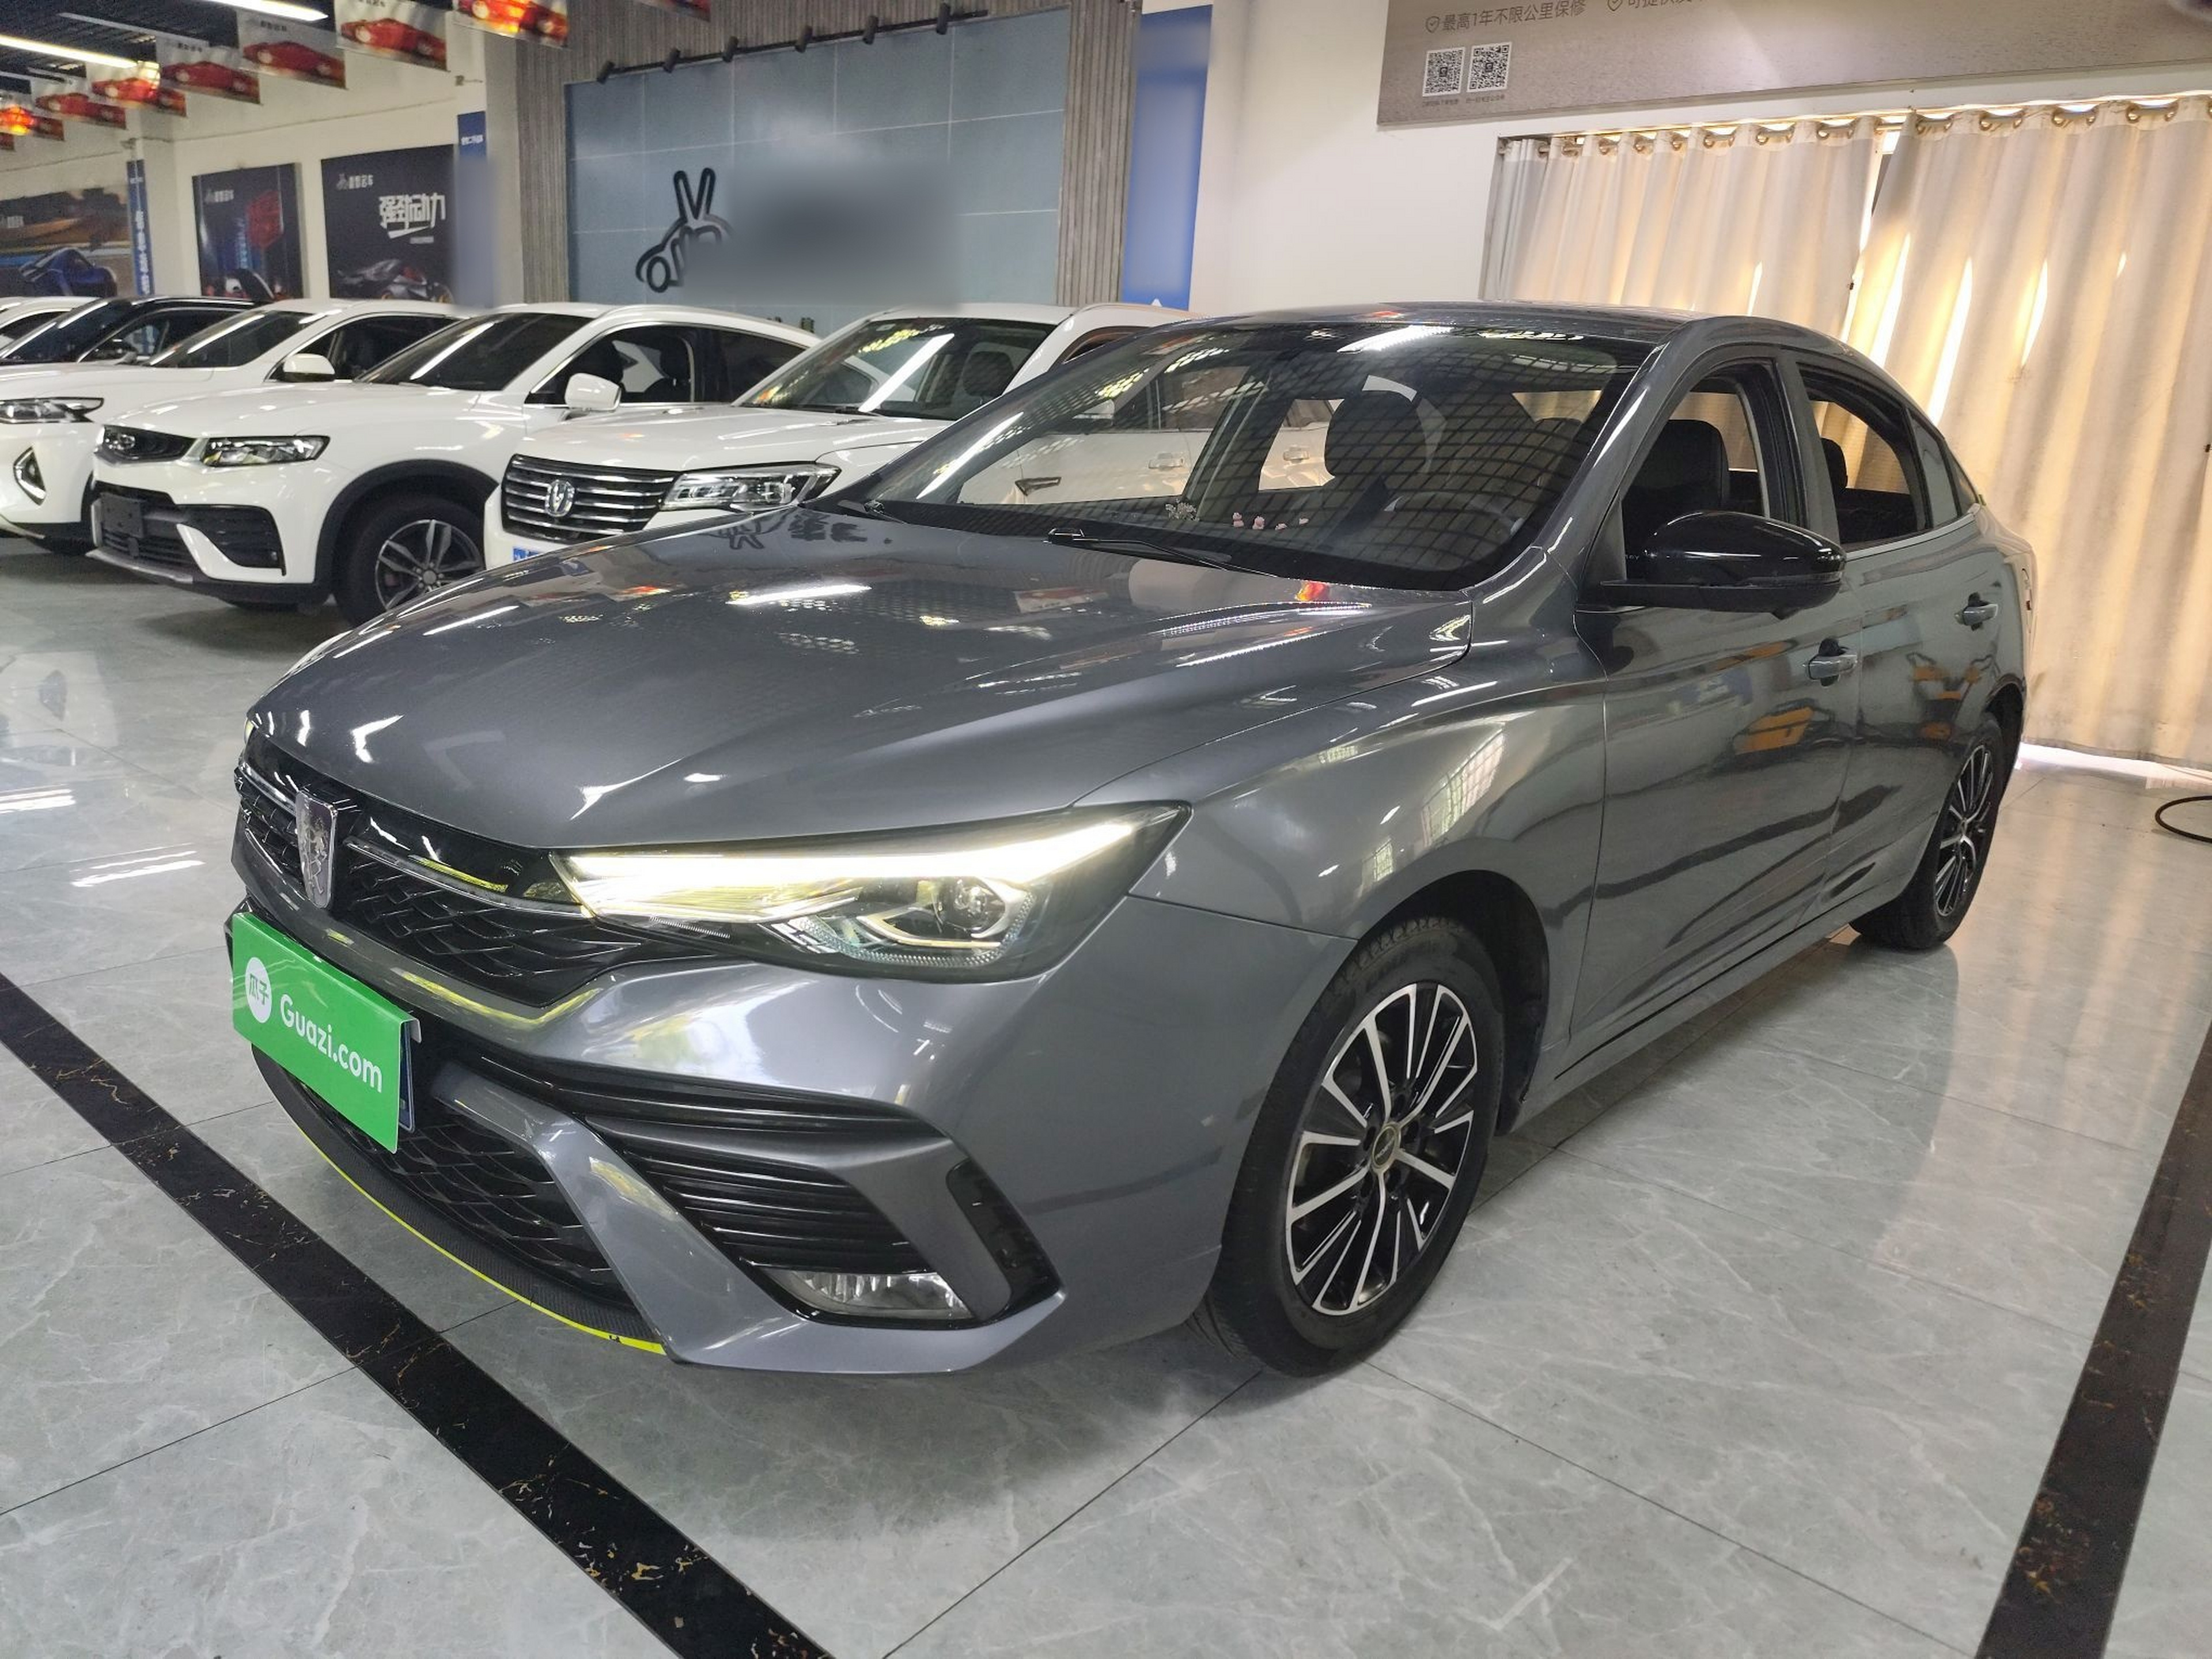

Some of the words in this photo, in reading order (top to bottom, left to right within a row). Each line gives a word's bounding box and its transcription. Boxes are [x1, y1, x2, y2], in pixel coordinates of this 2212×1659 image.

[1442, 0, 1585, 31] 最高1年不限公里保修
[249, 973, 270, 1006] 瓜子
[280, 994, 382, 1093] Guazi.com
